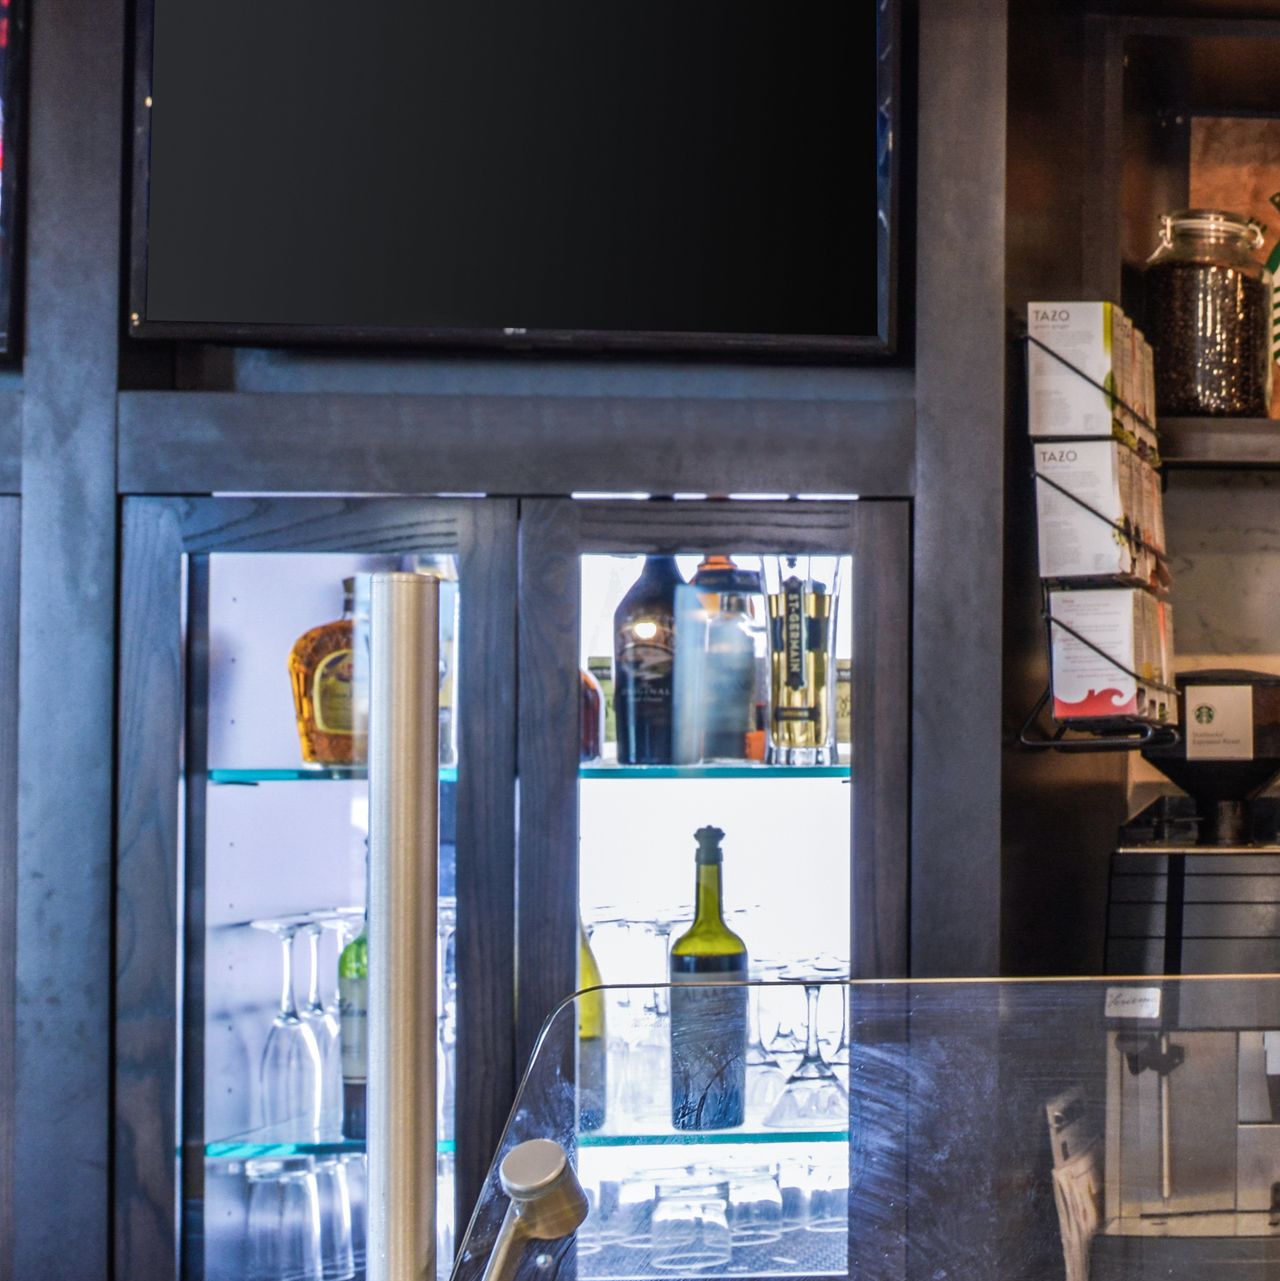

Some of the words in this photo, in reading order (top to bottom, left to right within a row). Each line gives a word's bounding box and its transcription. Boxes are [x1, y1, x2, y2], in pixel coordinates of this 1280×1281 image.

[1033, 310, 1070, 321] TAZO
[1042, 450, 1077, 462] TAZO
[787, 593, 800, 673] ST-GERMAIN
